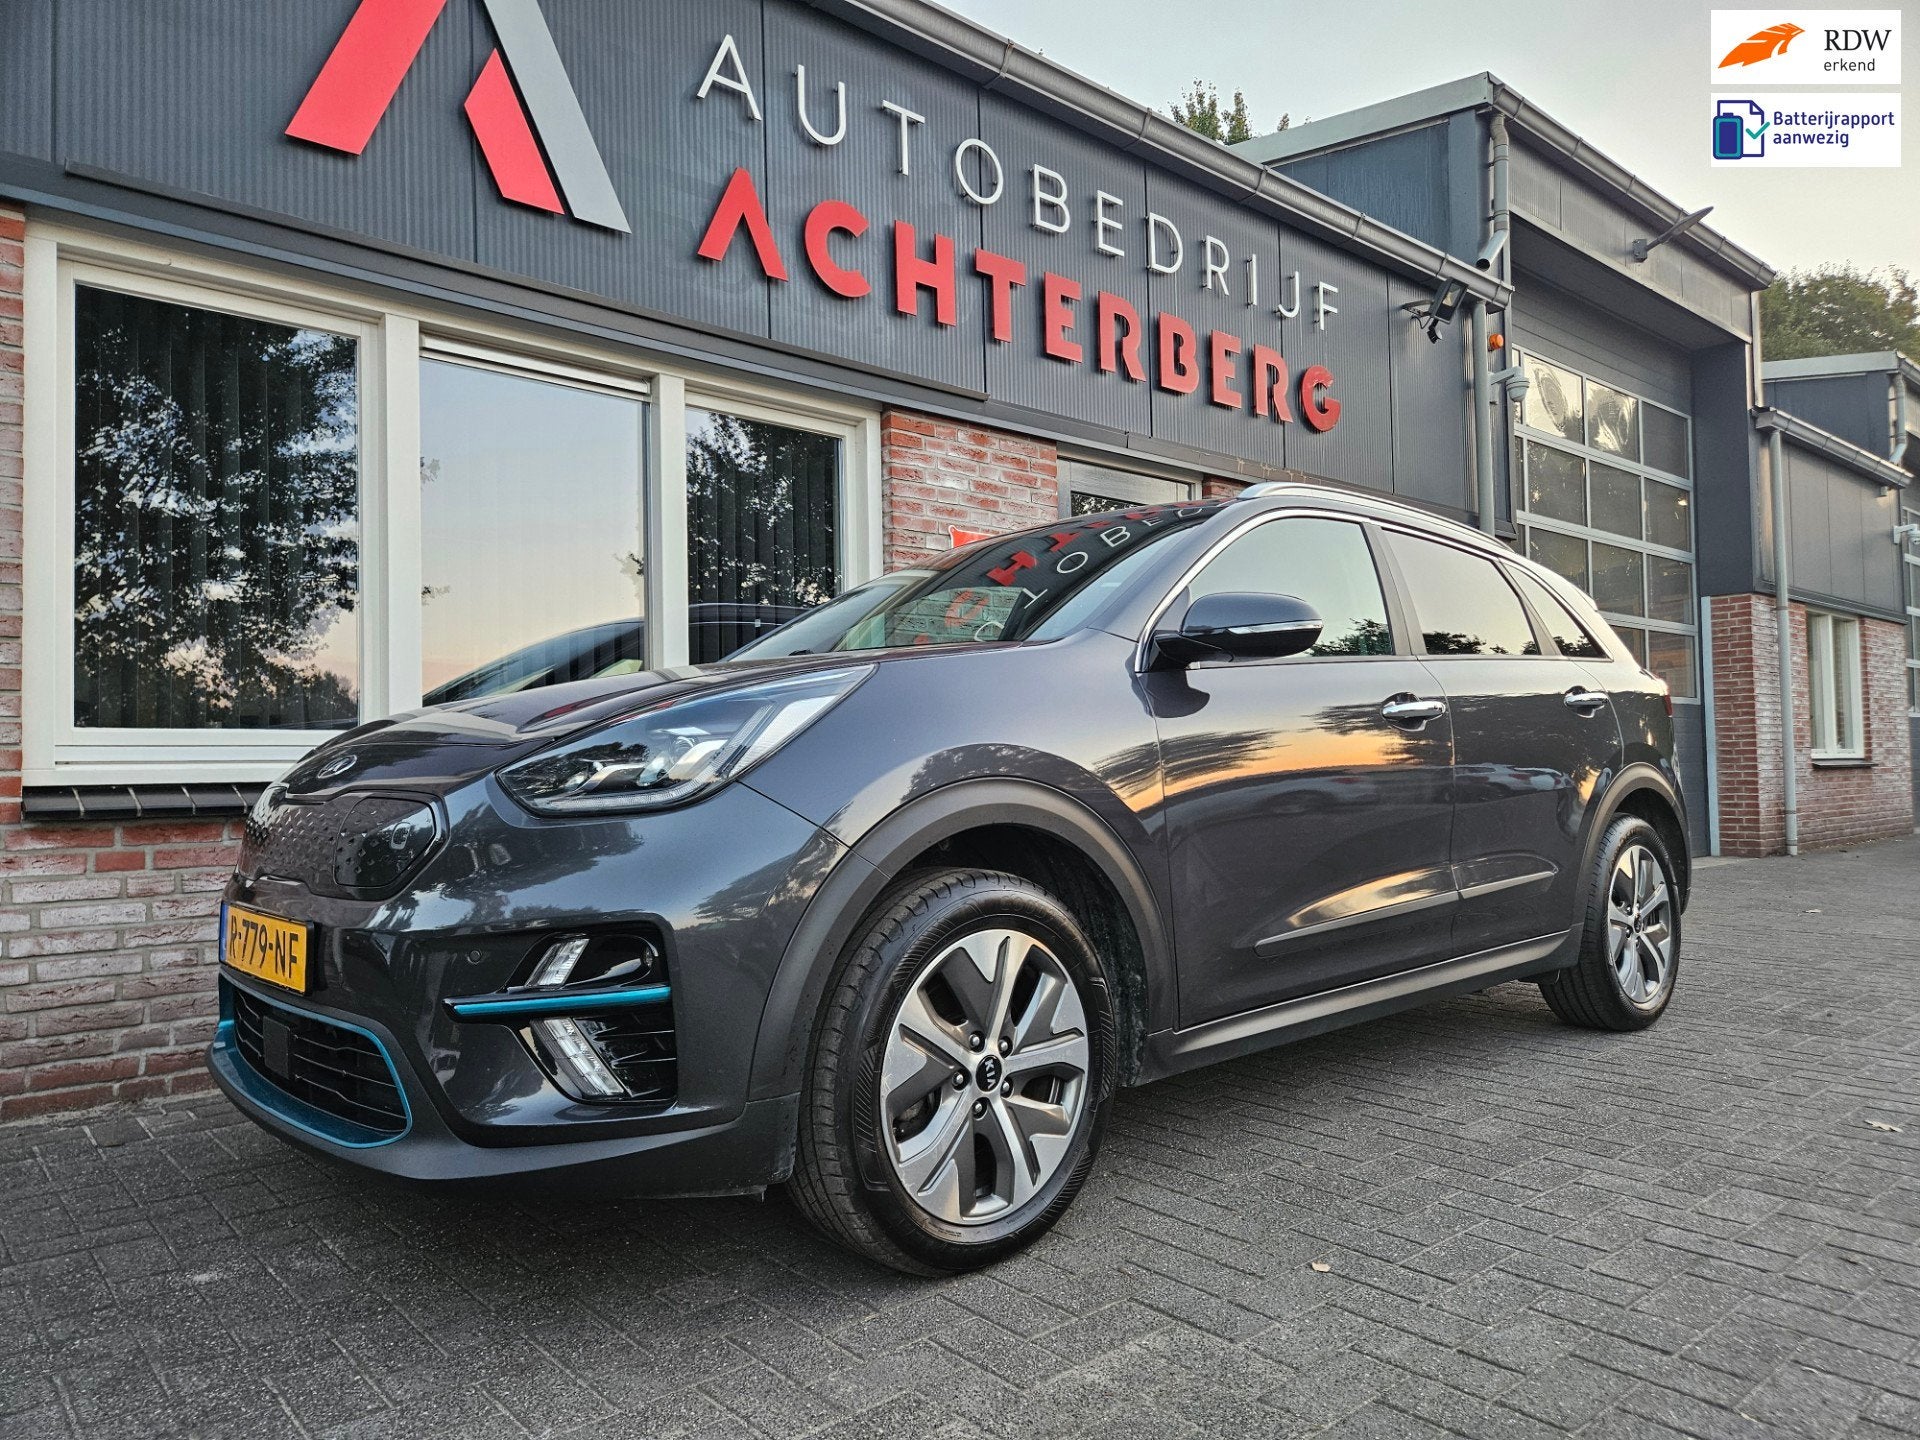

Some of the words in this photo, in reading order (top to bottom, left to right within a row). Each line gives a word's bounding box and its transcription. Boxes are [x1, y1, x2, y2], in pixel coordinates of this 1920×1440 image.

[696, 34, 1339, 330] AUTOBEDRIJF
[697, 167, 1342, 432] ACHTERBERG
[229, 914, 299, 979] R-779-NF
